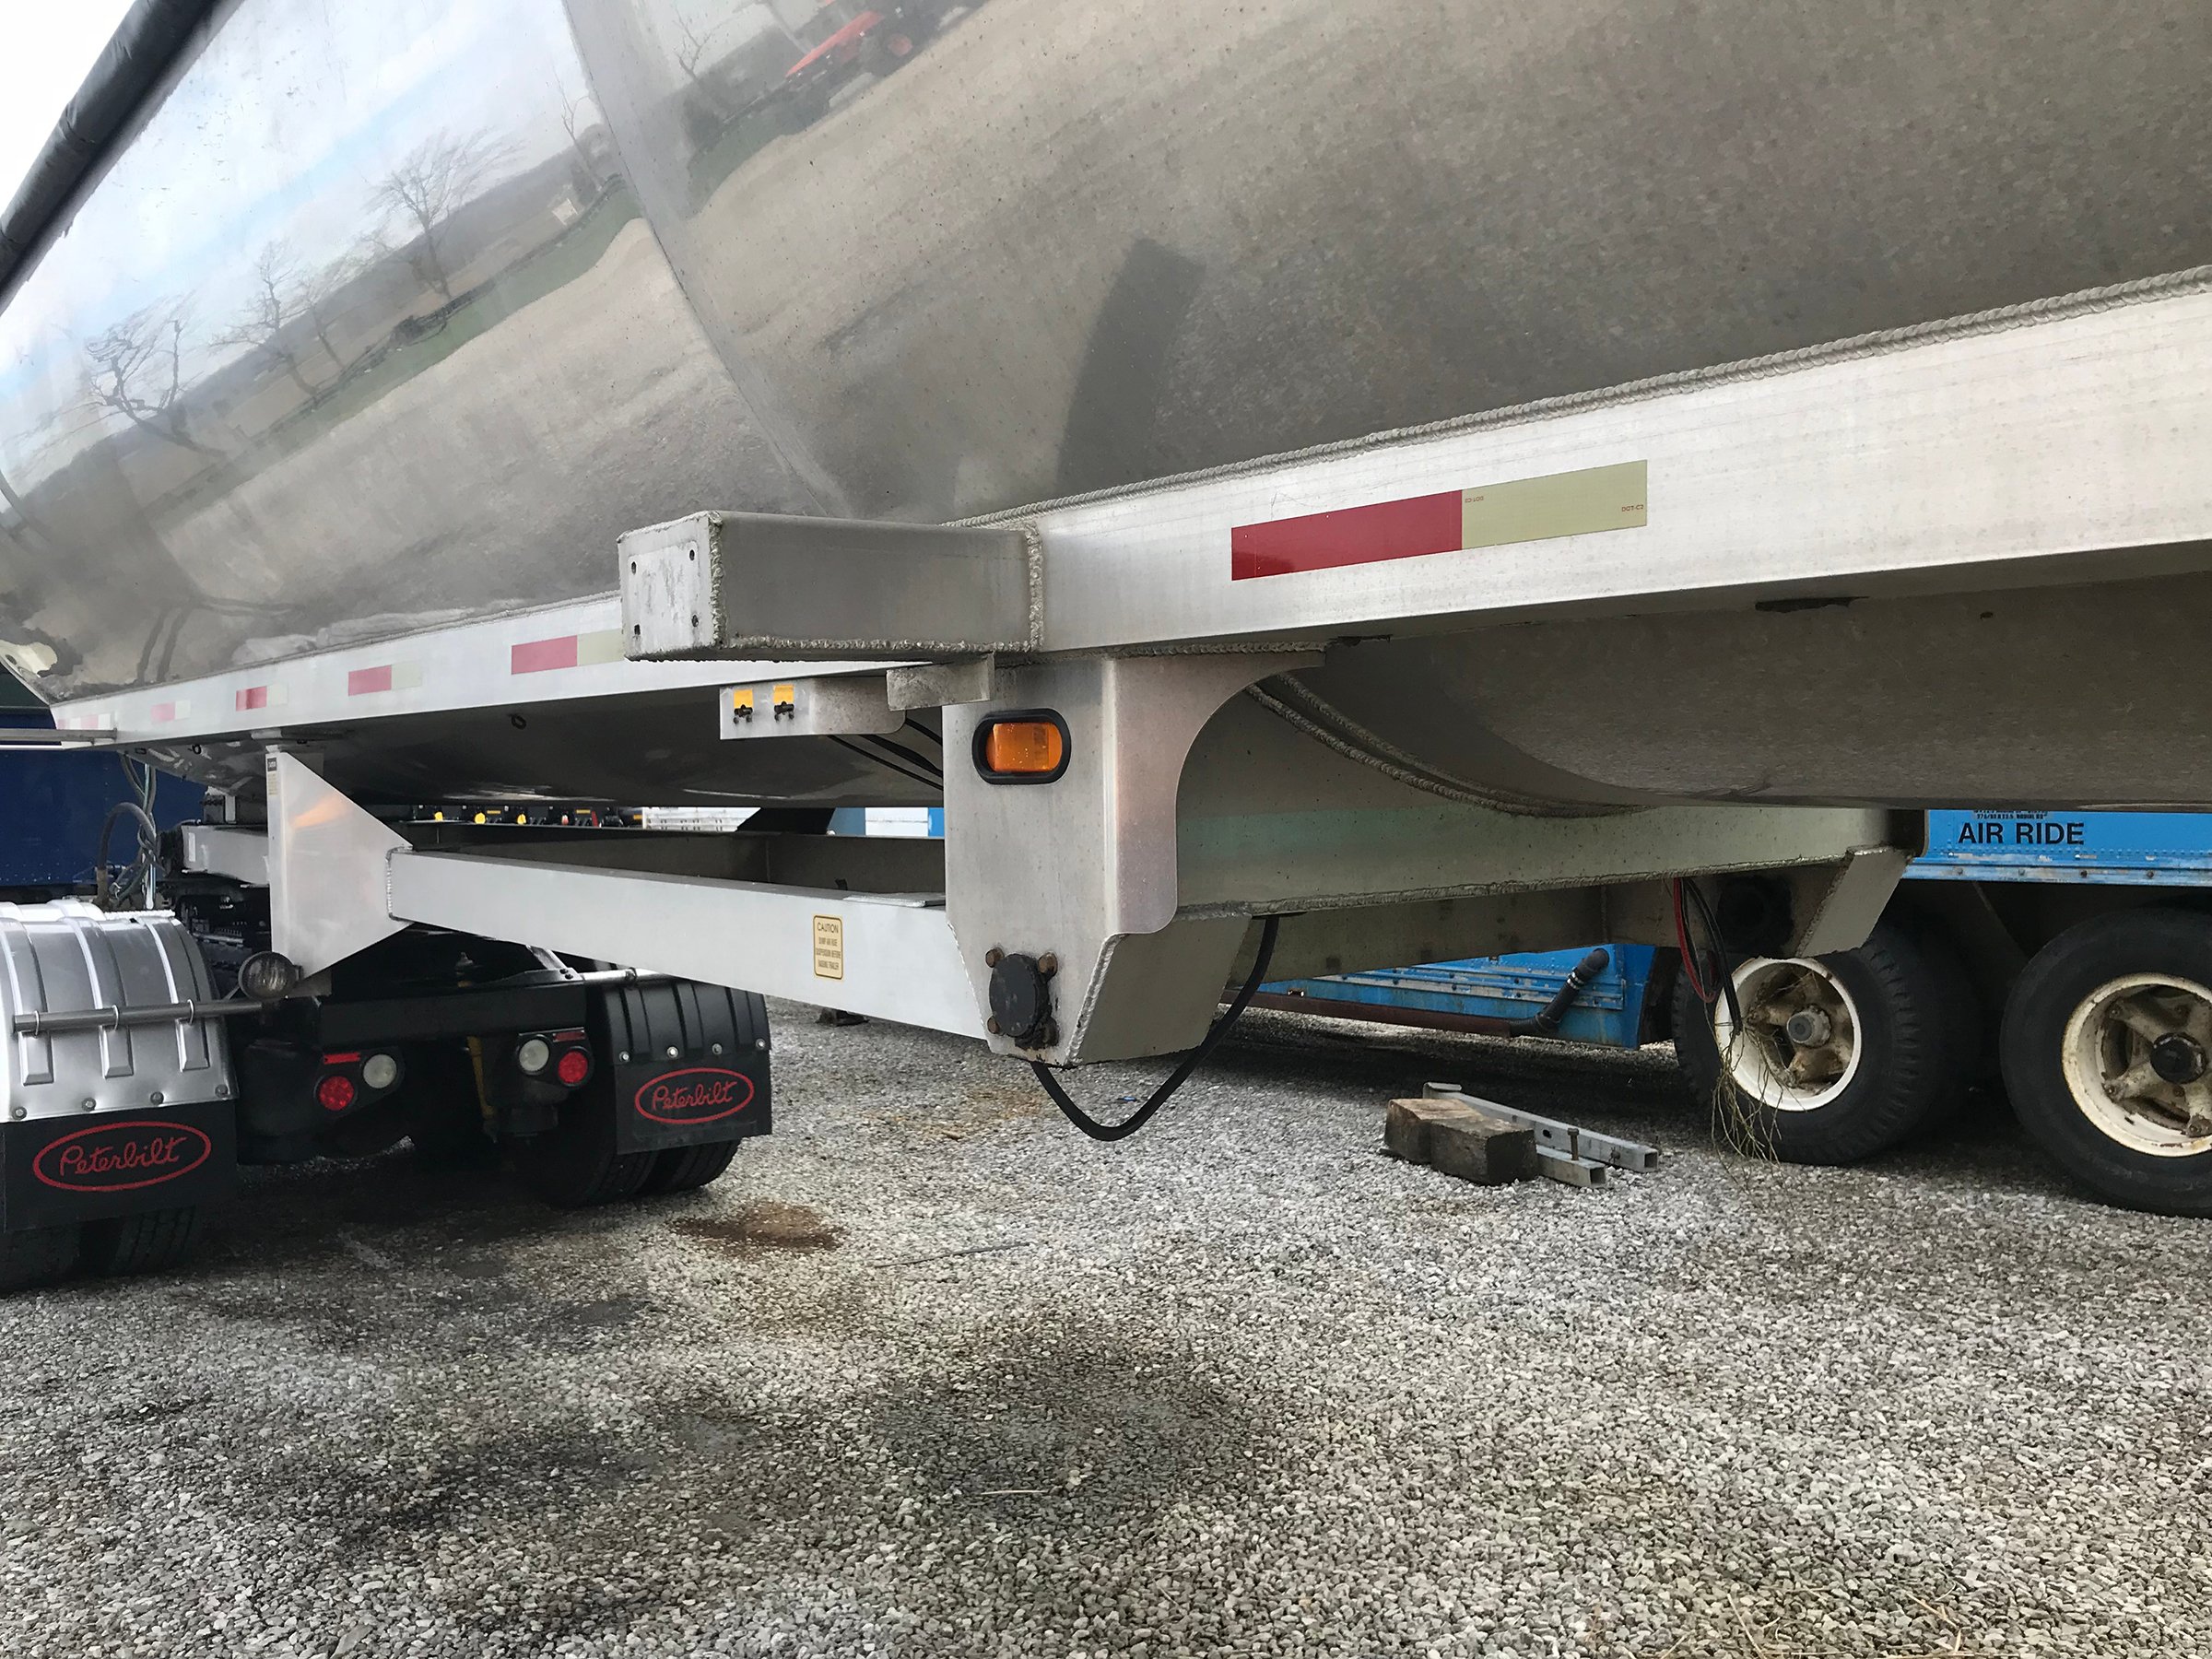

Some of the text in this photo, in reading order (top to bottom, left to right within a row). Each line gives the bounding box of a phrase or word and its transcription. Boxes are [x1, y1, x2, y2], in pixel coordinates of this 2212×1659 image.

[1958, 822, 2085, 845] AIR RIDE
[817, 922, 839, 934] CAUTION
[652, 1080, 737, 1112] Peterbilt
[59, 1136, 188, 1177] Peterbilt
